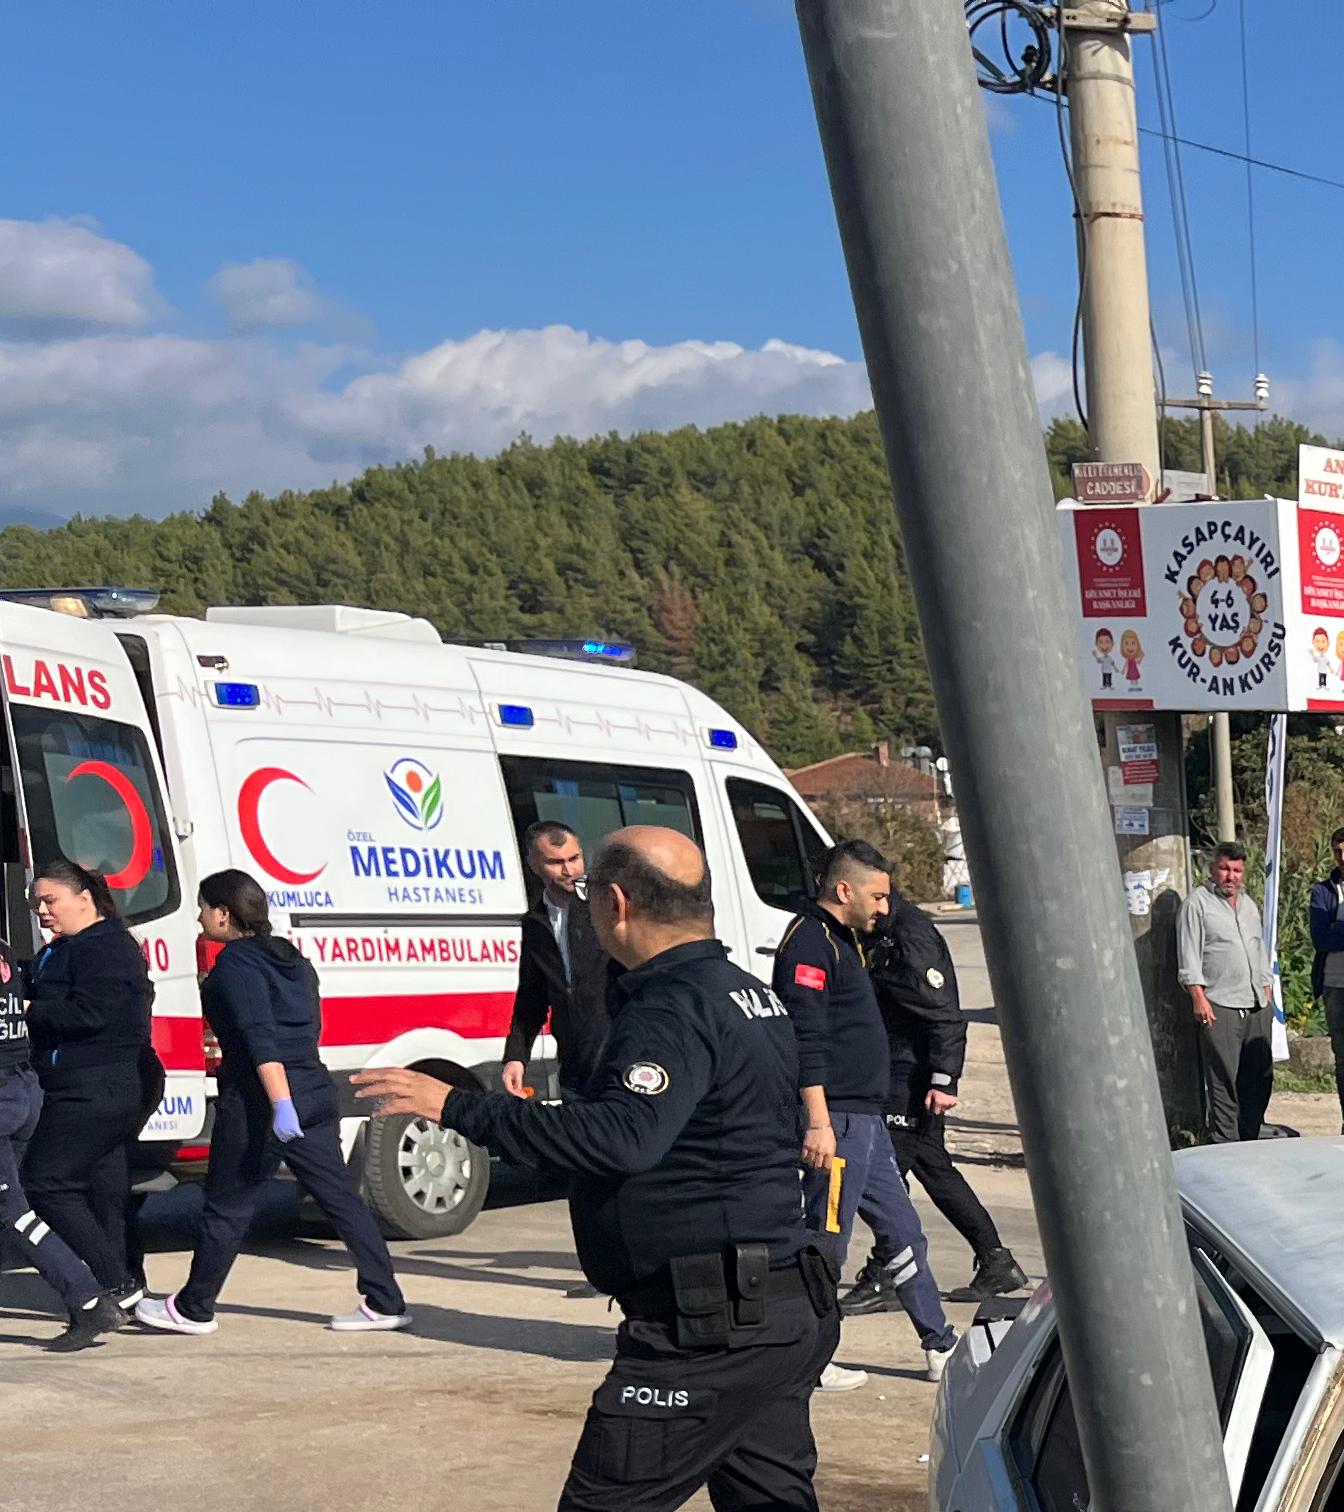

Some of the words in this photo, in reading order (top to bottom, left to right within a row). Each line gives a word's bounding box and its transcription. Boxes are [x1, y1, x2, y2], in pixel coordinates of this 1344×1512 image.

[1164, 520, 1280, 584] KASAPÇAYIRI
[1210, 589, 1234, 609] 4-6
[1207, 612, 1240, 634] YAŞ
[346, 829, 376, 843] ÖZEL
